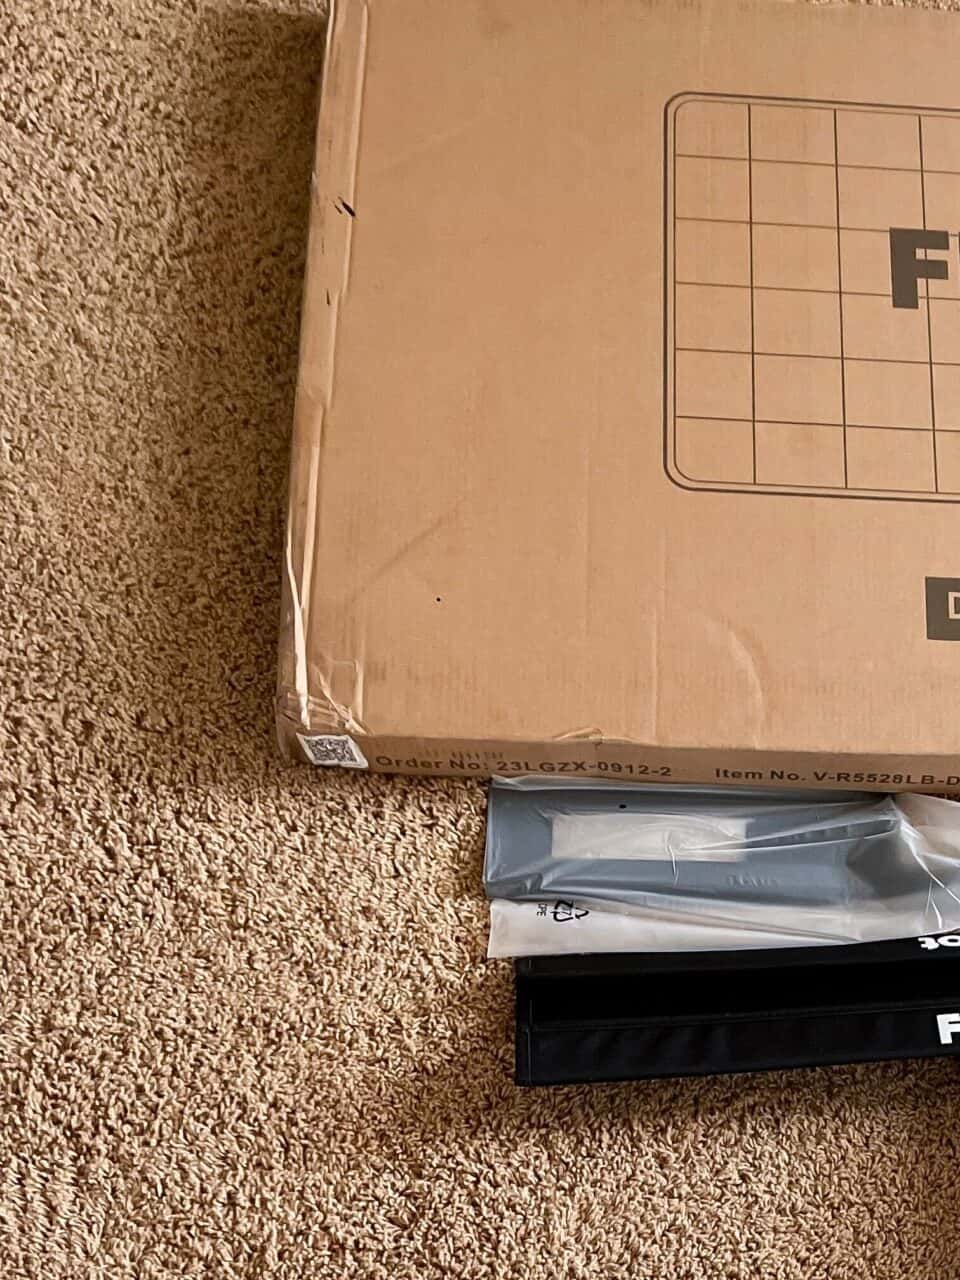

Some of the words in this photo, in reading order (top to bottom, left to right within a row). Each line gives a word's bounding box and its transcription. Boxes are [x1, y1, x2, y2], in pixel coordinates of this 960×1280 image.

[375, 755, 443, 769] Order
[450, 760, 489, 770] No:
[715, 768, 763, 780] Item
[770, 769, 806, 781] No.
